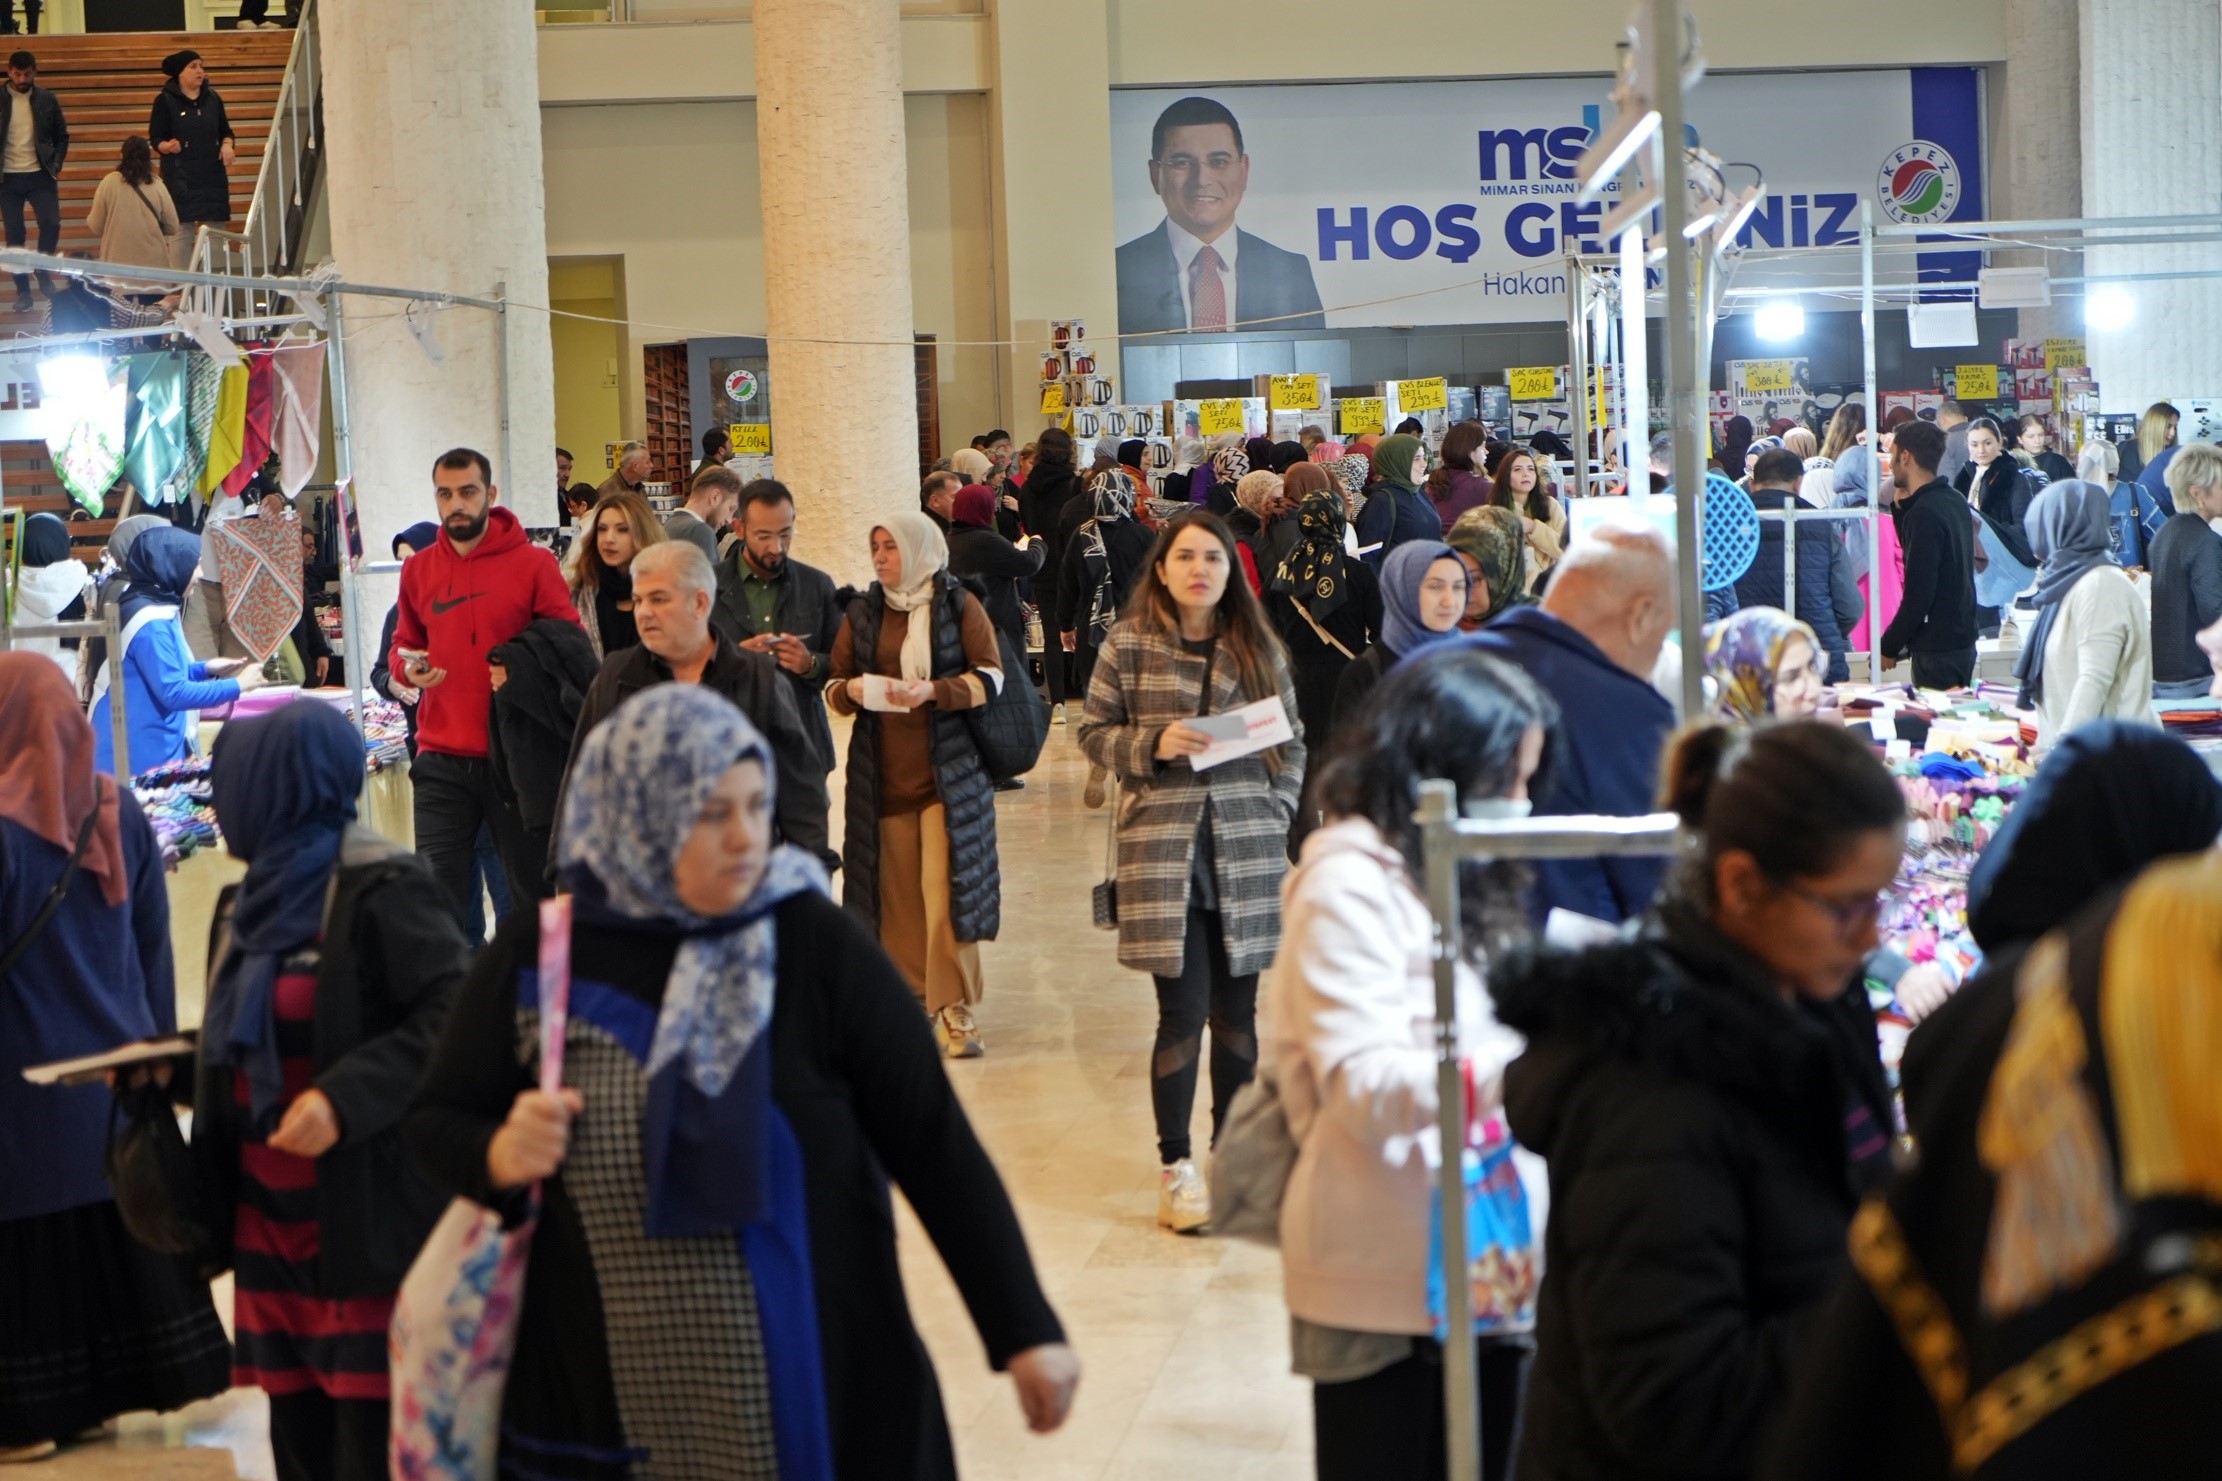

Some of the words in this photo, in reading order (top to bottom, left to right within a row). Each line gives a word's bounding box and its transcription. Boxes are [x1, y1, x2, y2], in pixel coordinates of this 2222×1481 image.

[1883, 147, 1950, 177] KEPEZ
[1317, 203, 1481, 263] HOŞ
[1484, 271, 1566, 296] Hakan
